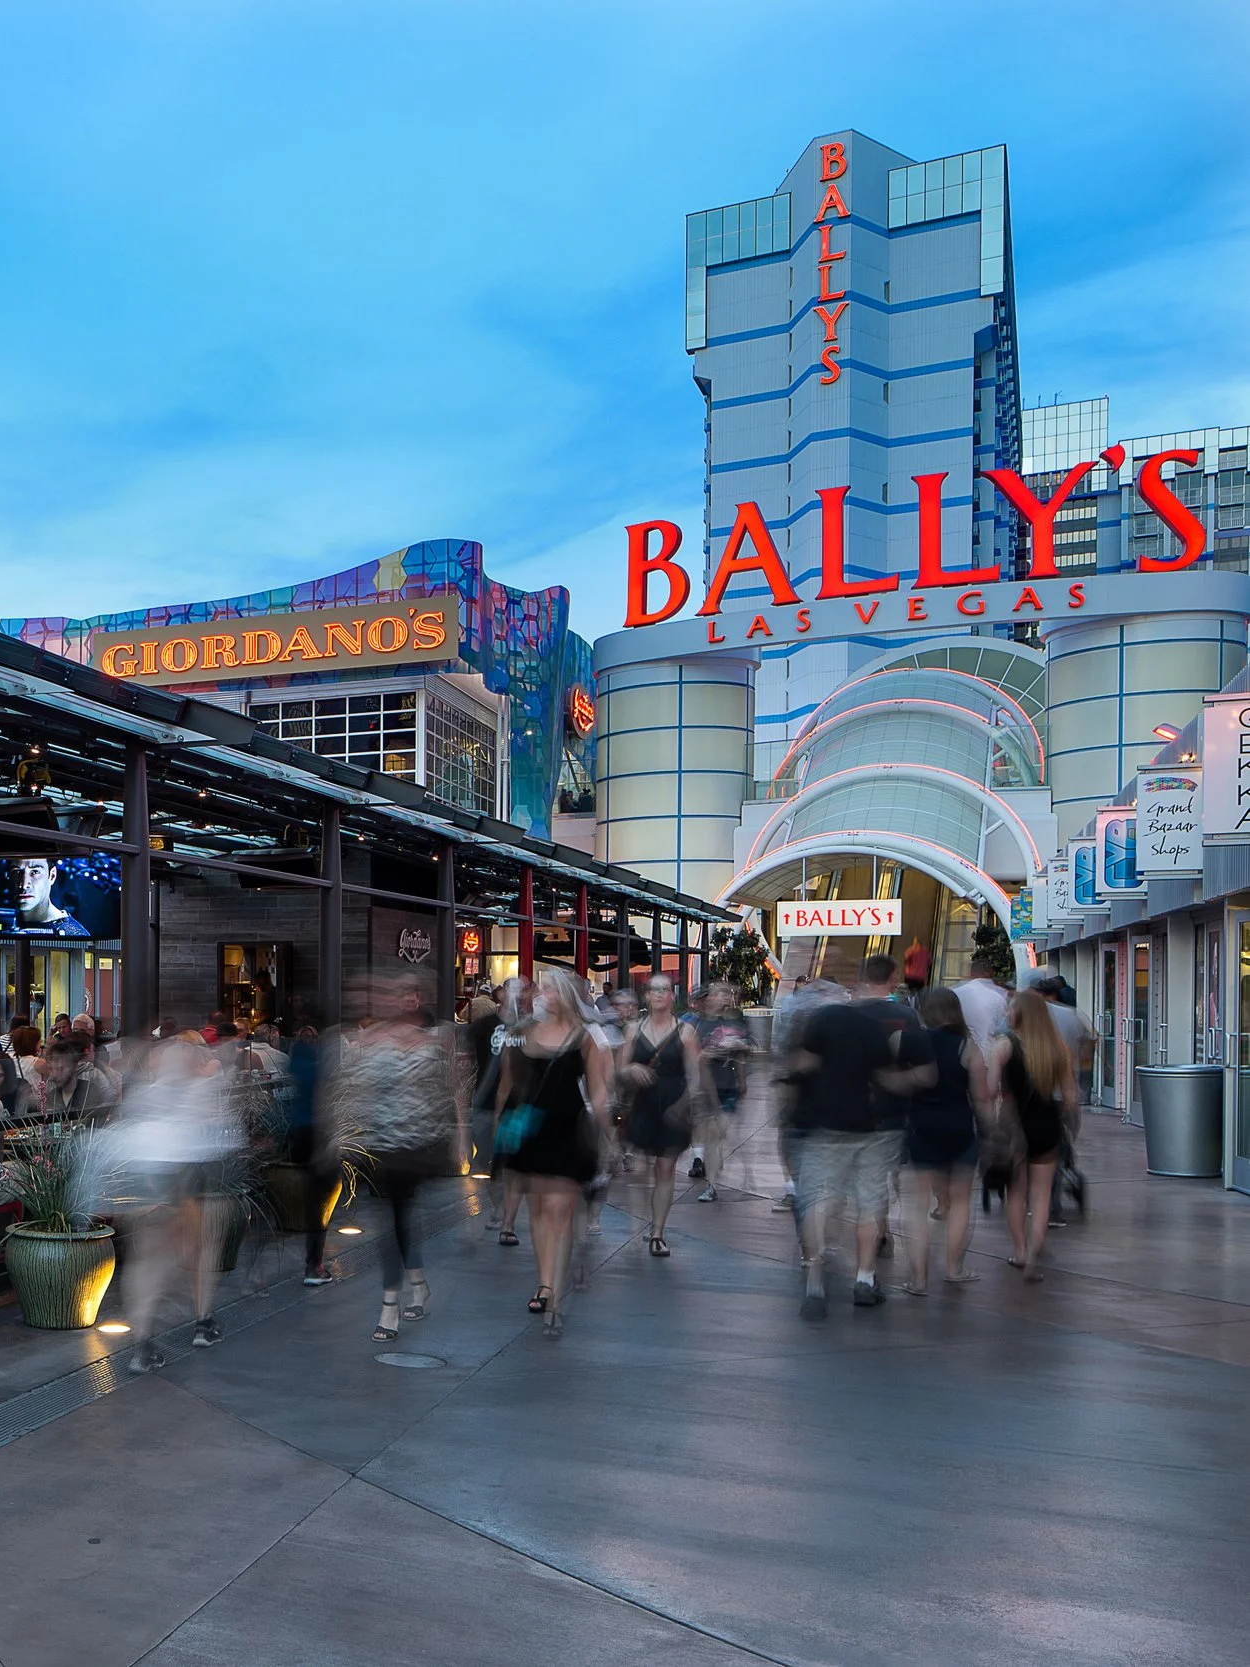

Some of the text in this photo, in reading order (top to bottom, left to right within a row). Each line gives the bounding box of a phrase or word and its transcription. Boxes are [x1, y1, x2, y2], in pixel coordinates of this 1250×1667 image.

[623, 444, 1206, 628] BALLY'S
[707, 582, 1087, 643] LAS VEGAS
[102, 608, 446, 677] GIORDANO'S
[1147, 796, 1193, 817] Grand
[1143, 819, 1198, 836] Bazaar
[796, 907, 881, 927] BALLY'S
